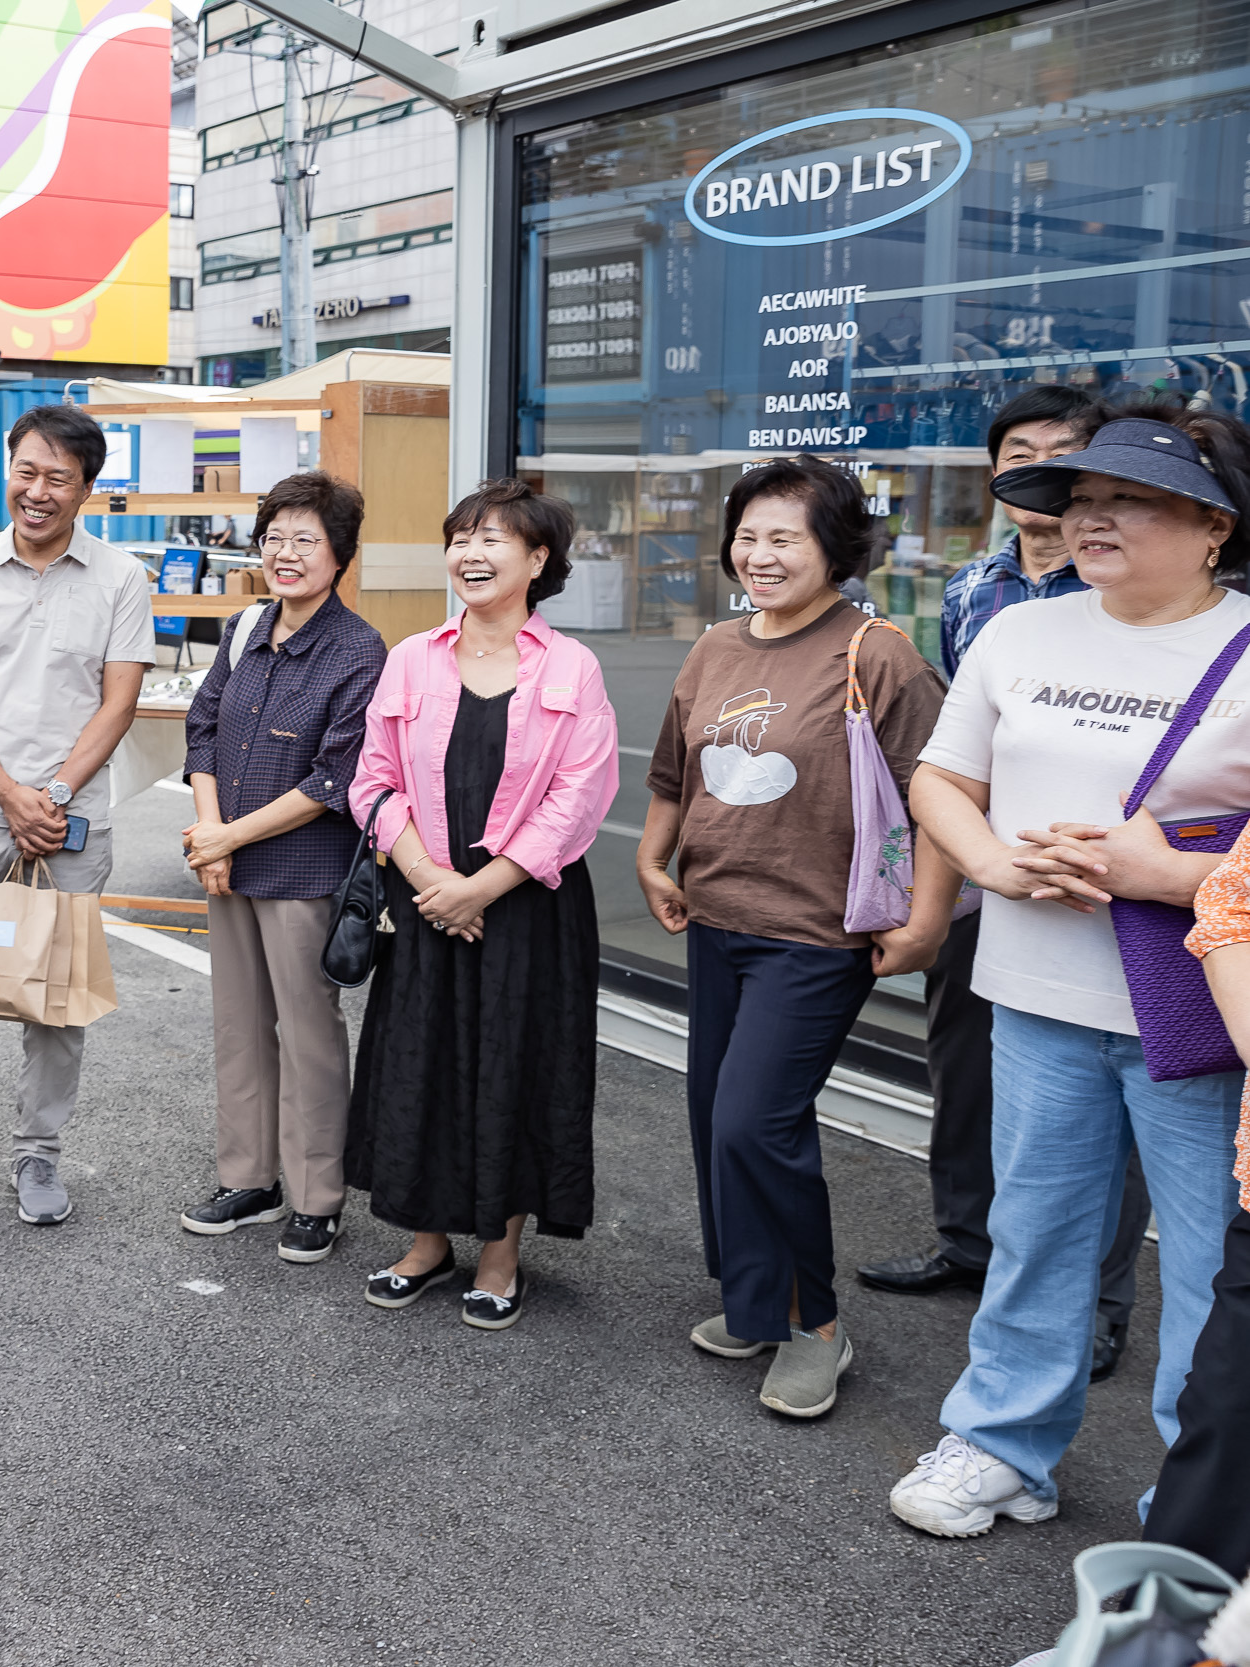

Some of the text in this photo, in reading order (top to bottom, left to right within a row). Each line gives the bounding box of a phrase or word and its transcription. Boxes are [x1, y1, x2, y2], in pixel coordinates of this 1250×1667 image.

[705, 140, 942, 218] BRAND LIST
[315, 296, 360, 323] ZERO
[758, 284, 867, 314] AECAWHITE
[762, 321, 859, 347] AJOBYAJO
[788, 358, 829, 379] AOR
[765, 391, 852, 414] BALANSA
[749, 426, 868, 448] BEN DAVIS JP
[1030, 686, 1201, 727] AMOUREU
[1209, 699, 1246, 719] IE
[1073, 718, 1131, 733] JE T'AIME
